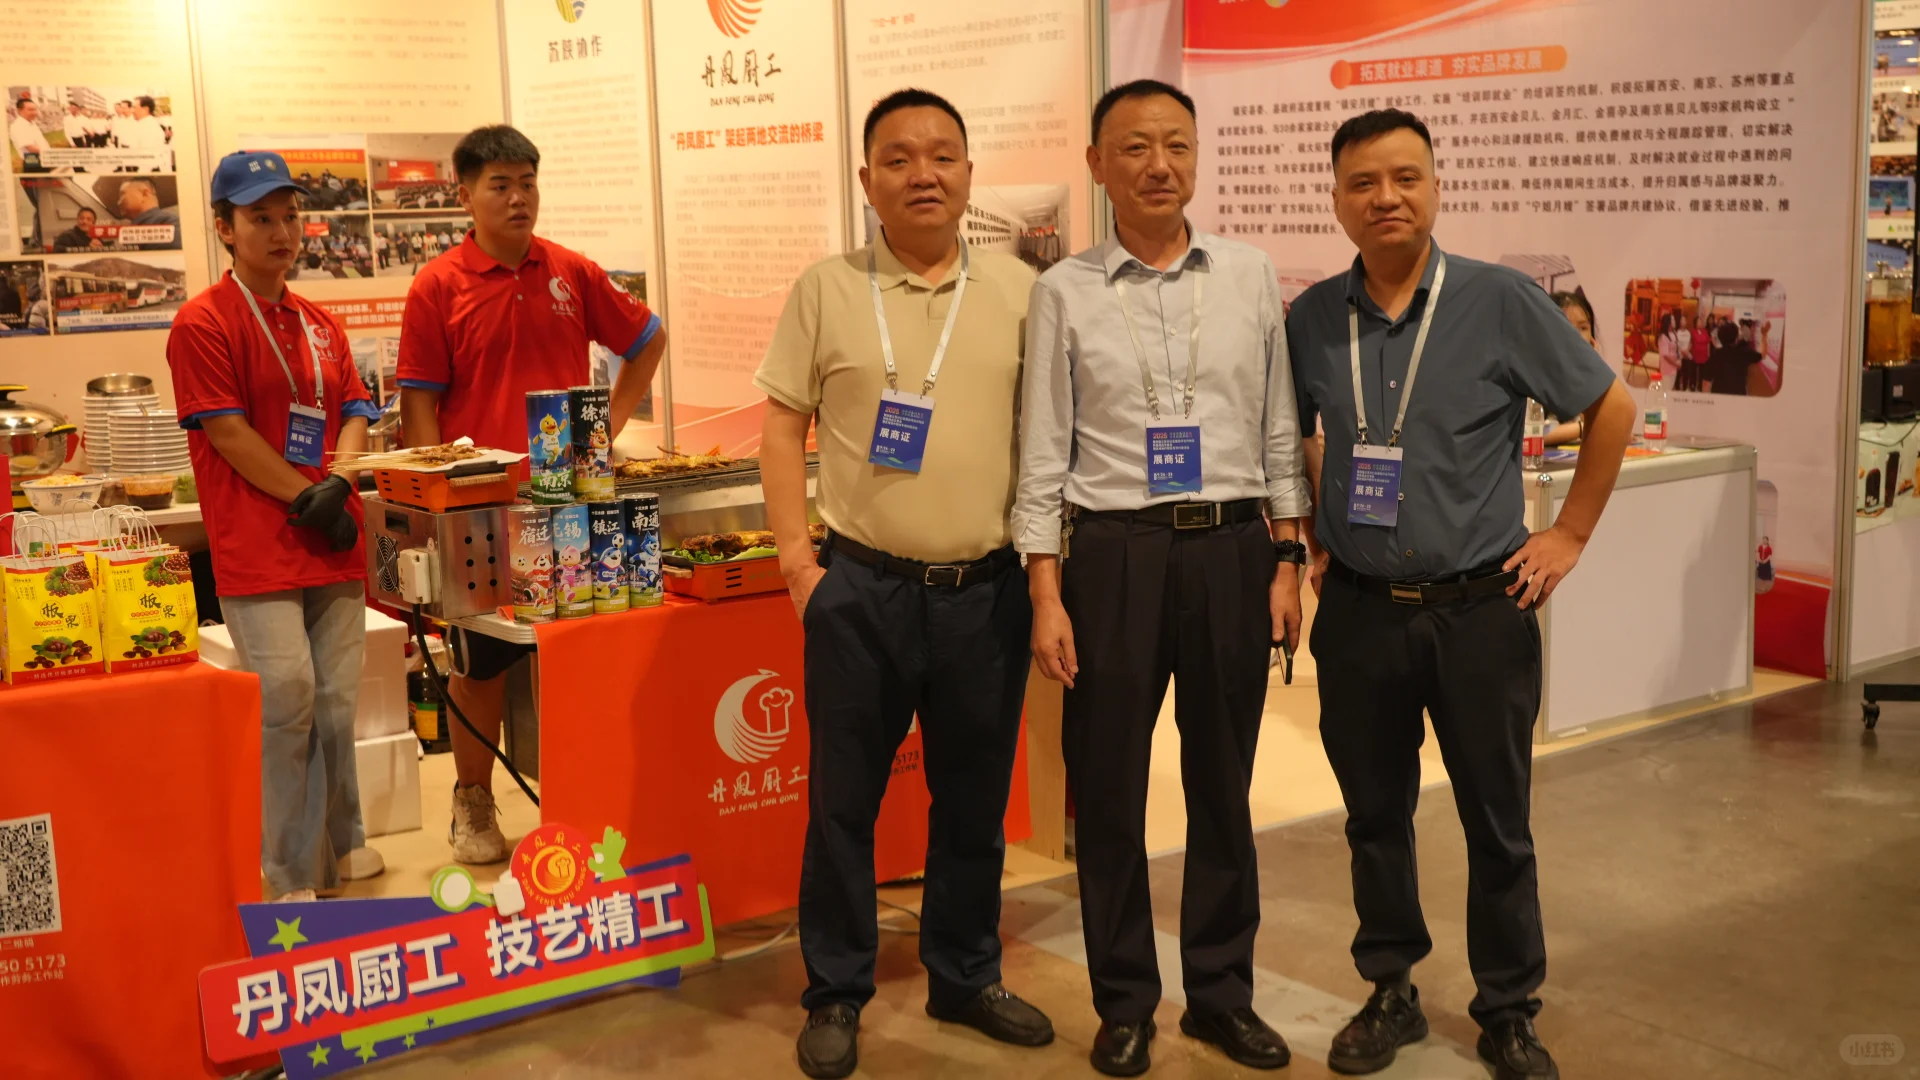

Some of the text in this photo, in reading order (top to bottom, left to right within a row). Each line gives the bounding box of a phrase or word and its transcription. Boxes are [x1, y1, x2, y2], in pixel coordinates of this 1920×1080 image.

[548, 34, 603, 63] 苏陕协作
[702, 49, 781, 88] 丹凤厨工
[1360, 49, 1543, 82] 拓宽就业渠道 夯实品牌发展
[670, 121, 824, 151] “丹凤厨工”架起两地交流的桥梁
[581, 402, 611, 422] 徐州
[290, 432, 313, 445] 展商证
[880, 427, 911, 443] 展商证
[1153, 454, 1185, 465] 展商证
[539, 467, 572, 490] 南京
[1355, 484, 1384, 497] 展商证
[592, 519, 621, 535] 镇江
[631, 511, 660, 535] 南通
[518, 525, 551, 545] 宿迁
[42, 602, 79, 628] 板栗
[139, 593, 176, 618] 板栗
[708, 765, 807, 803] 丹凤厨工
[719, 806, 736, 816] DAN
[0, 937, 35, 950] 二维码
[26, 954, 66, 972] 5173
[232, 881, 686, 1038] 丹凤厨工 技艺精工
